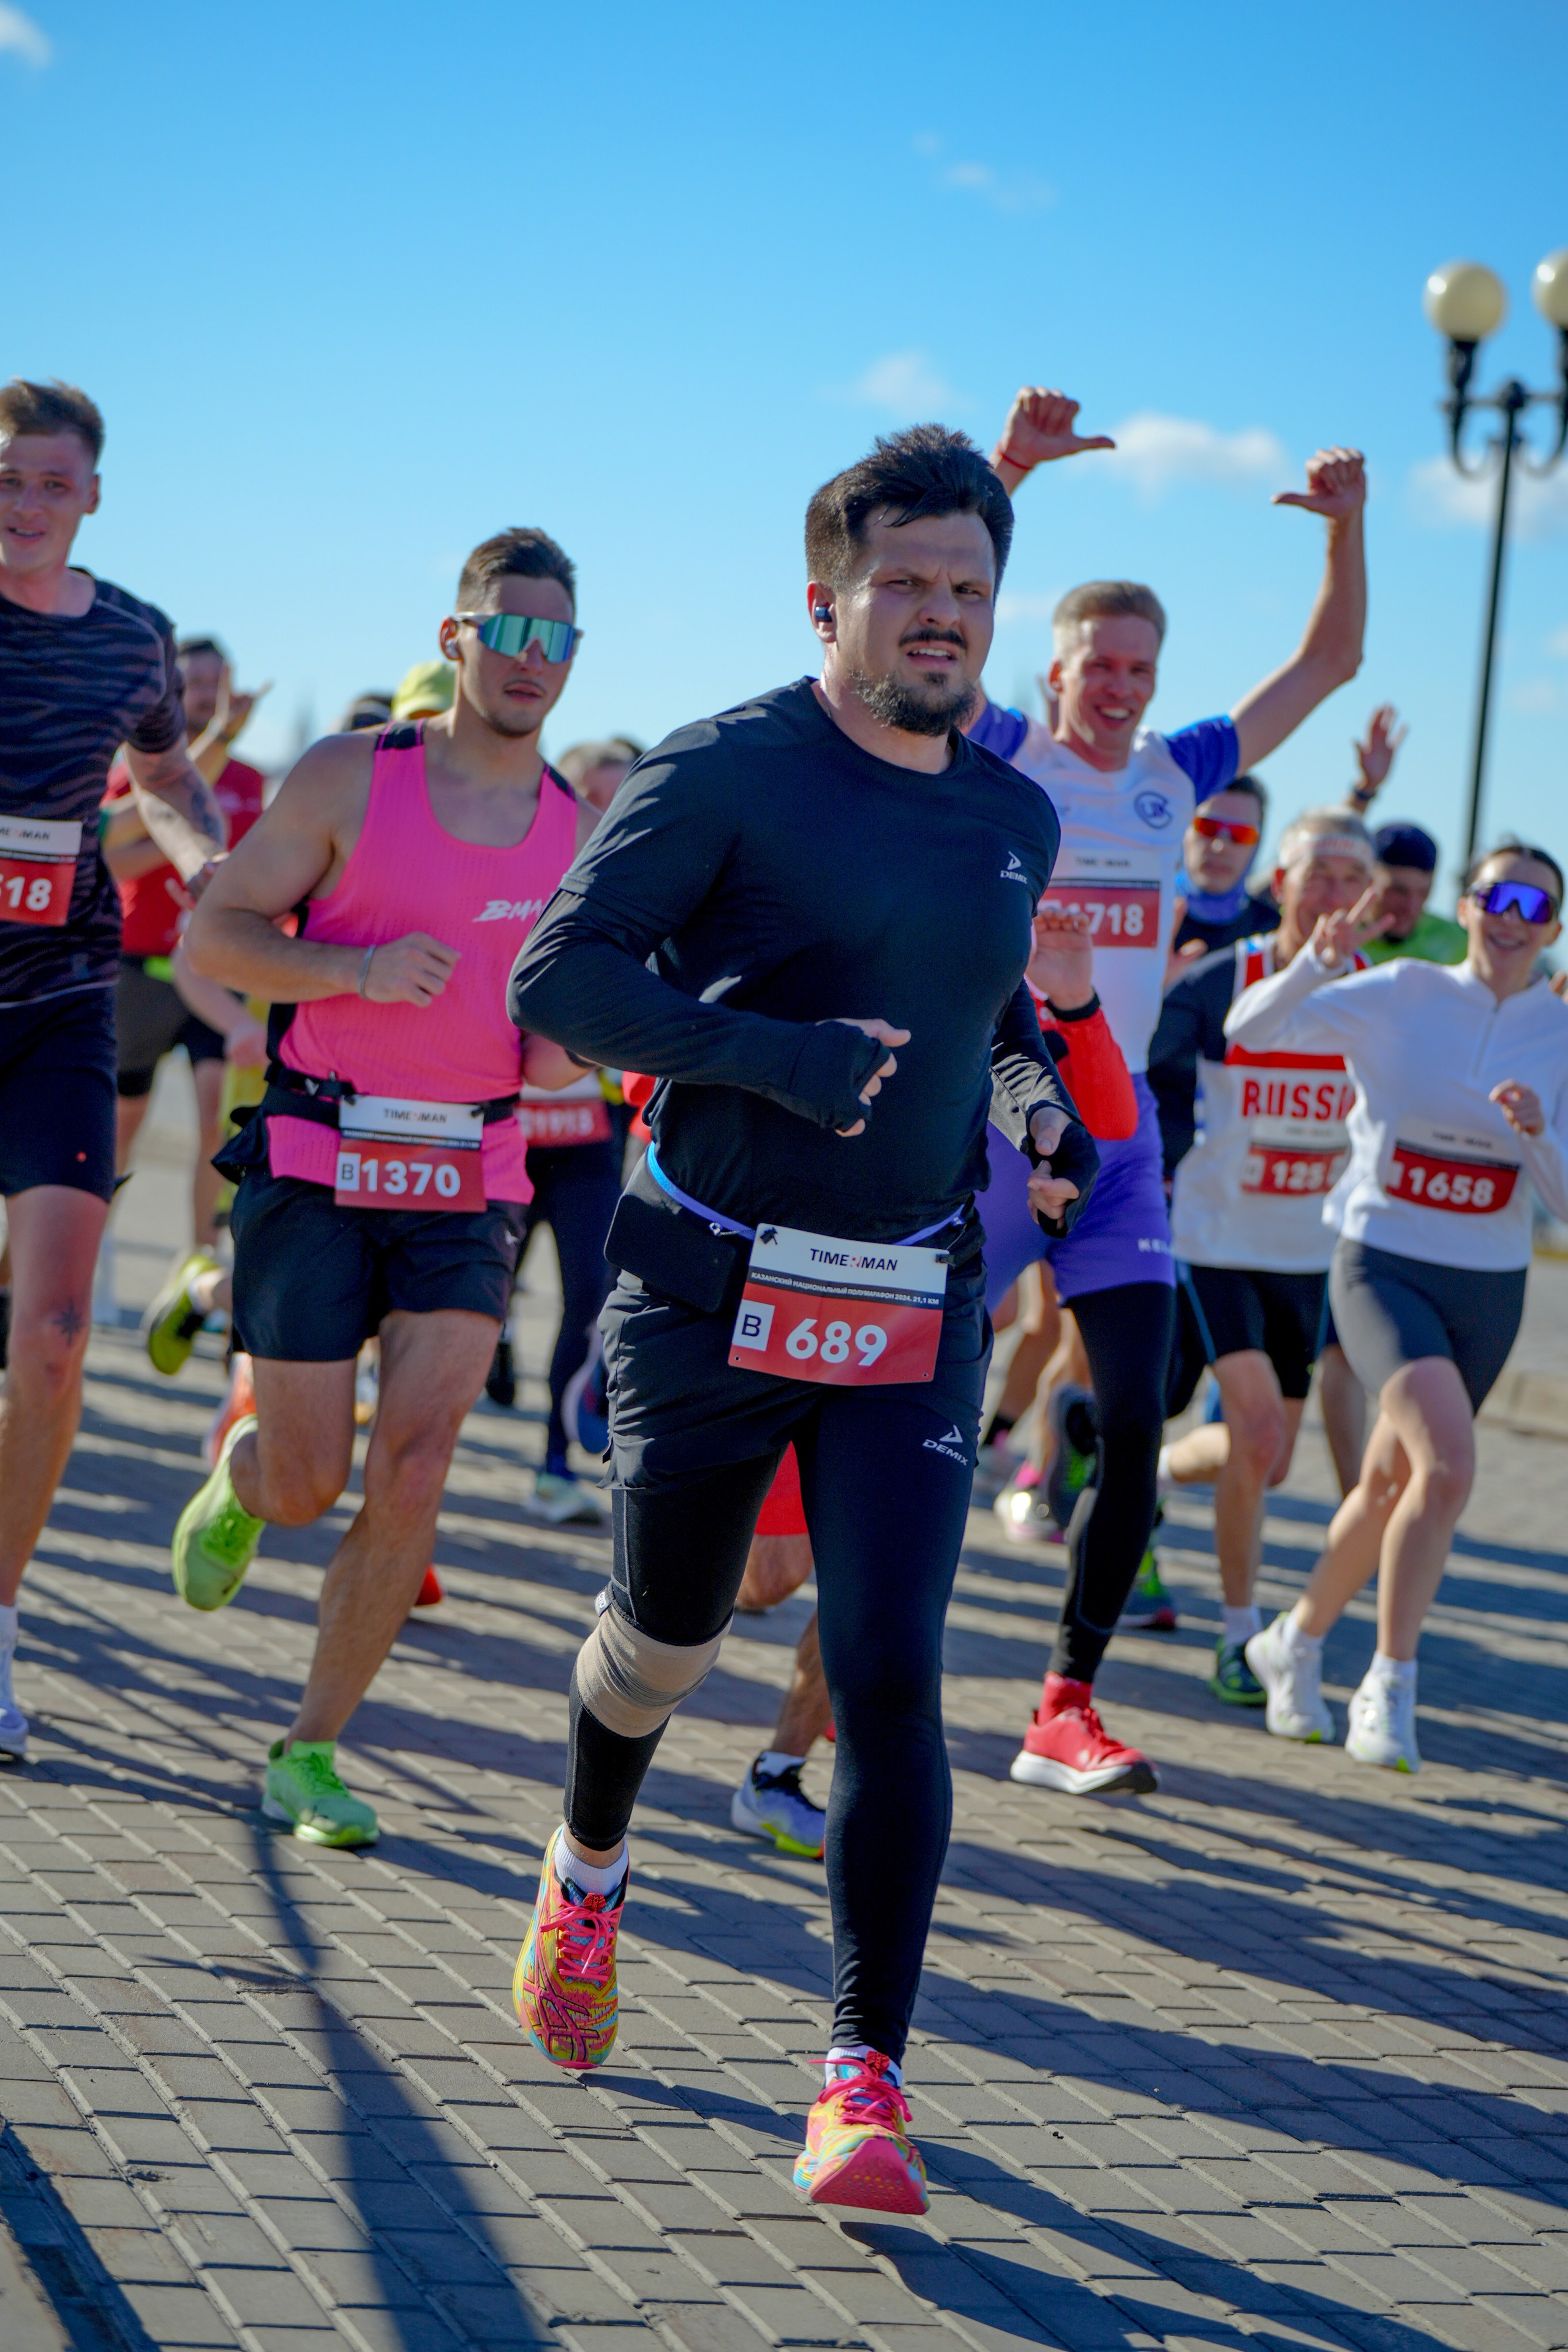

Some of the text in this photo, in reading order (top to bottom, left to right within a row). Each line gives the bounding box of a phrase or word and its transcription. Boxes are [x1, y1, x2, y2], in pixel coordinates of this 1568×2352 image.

[0, 873, 53, 911] 18
[1242, 1079, 1357, 1121] RUSSI
[342, 1159, 461, 1197] B 1370
[1408, 1166, 1496, 1208] 1658
[751, 1272, 793, 1286] КАЗАНСКИЙ
[793, 1280, 848, 1294] НАЦИОНАЛЬНЫЙ
[848, 1288, 895, 1300] ПОЛУМАРАФОН
[913, 1295, 927, 1304] 21,1
[741, 1313, 888, 1366] B 689
[922, 1438, 969, 1466] DEMIX
